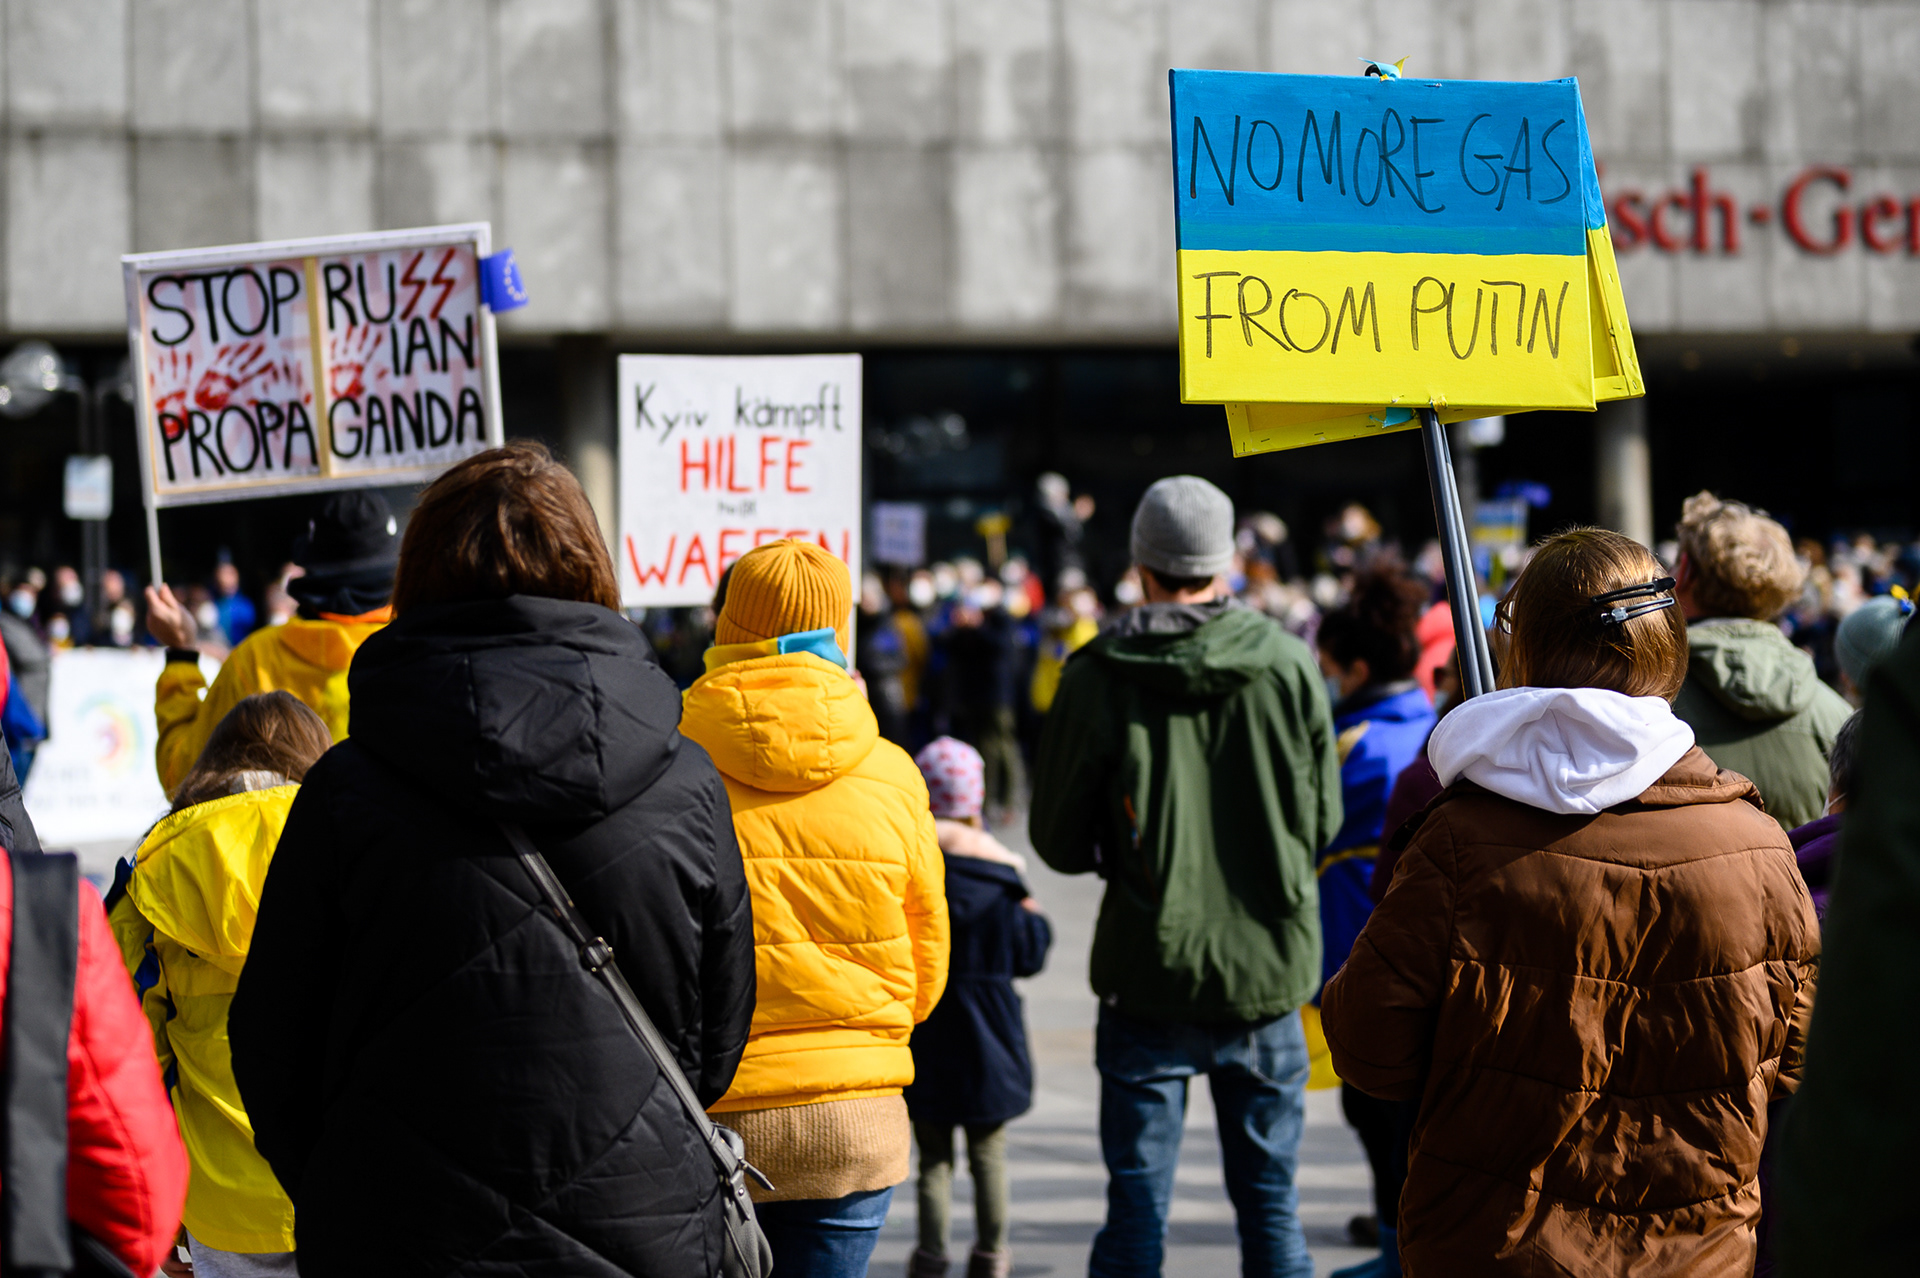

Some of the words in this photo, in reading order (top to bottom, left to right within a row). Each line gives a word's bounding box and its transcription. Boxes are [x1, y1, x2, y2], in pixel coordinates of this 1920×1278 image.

[1190, 115, 1284, 206] NO
[1298, 107, 1446, 213] MORE
[1458, 113, 1571, 212] GAS
[1597, 160, 1920, 256] sch-Ge
[147, 267, 301, 346] STOP
[1192, 271, 1382, 359] FROM
[1411, 276, 1570, 360] PUTIN
[158, 401, 319, 483] PROPA
[328, 387, 487, 460] GANDA
[634, 382, 709, 446] Kyiv
[734, 381, 843, 437] kämpft
[680, 434, 813, 494] HILFE
